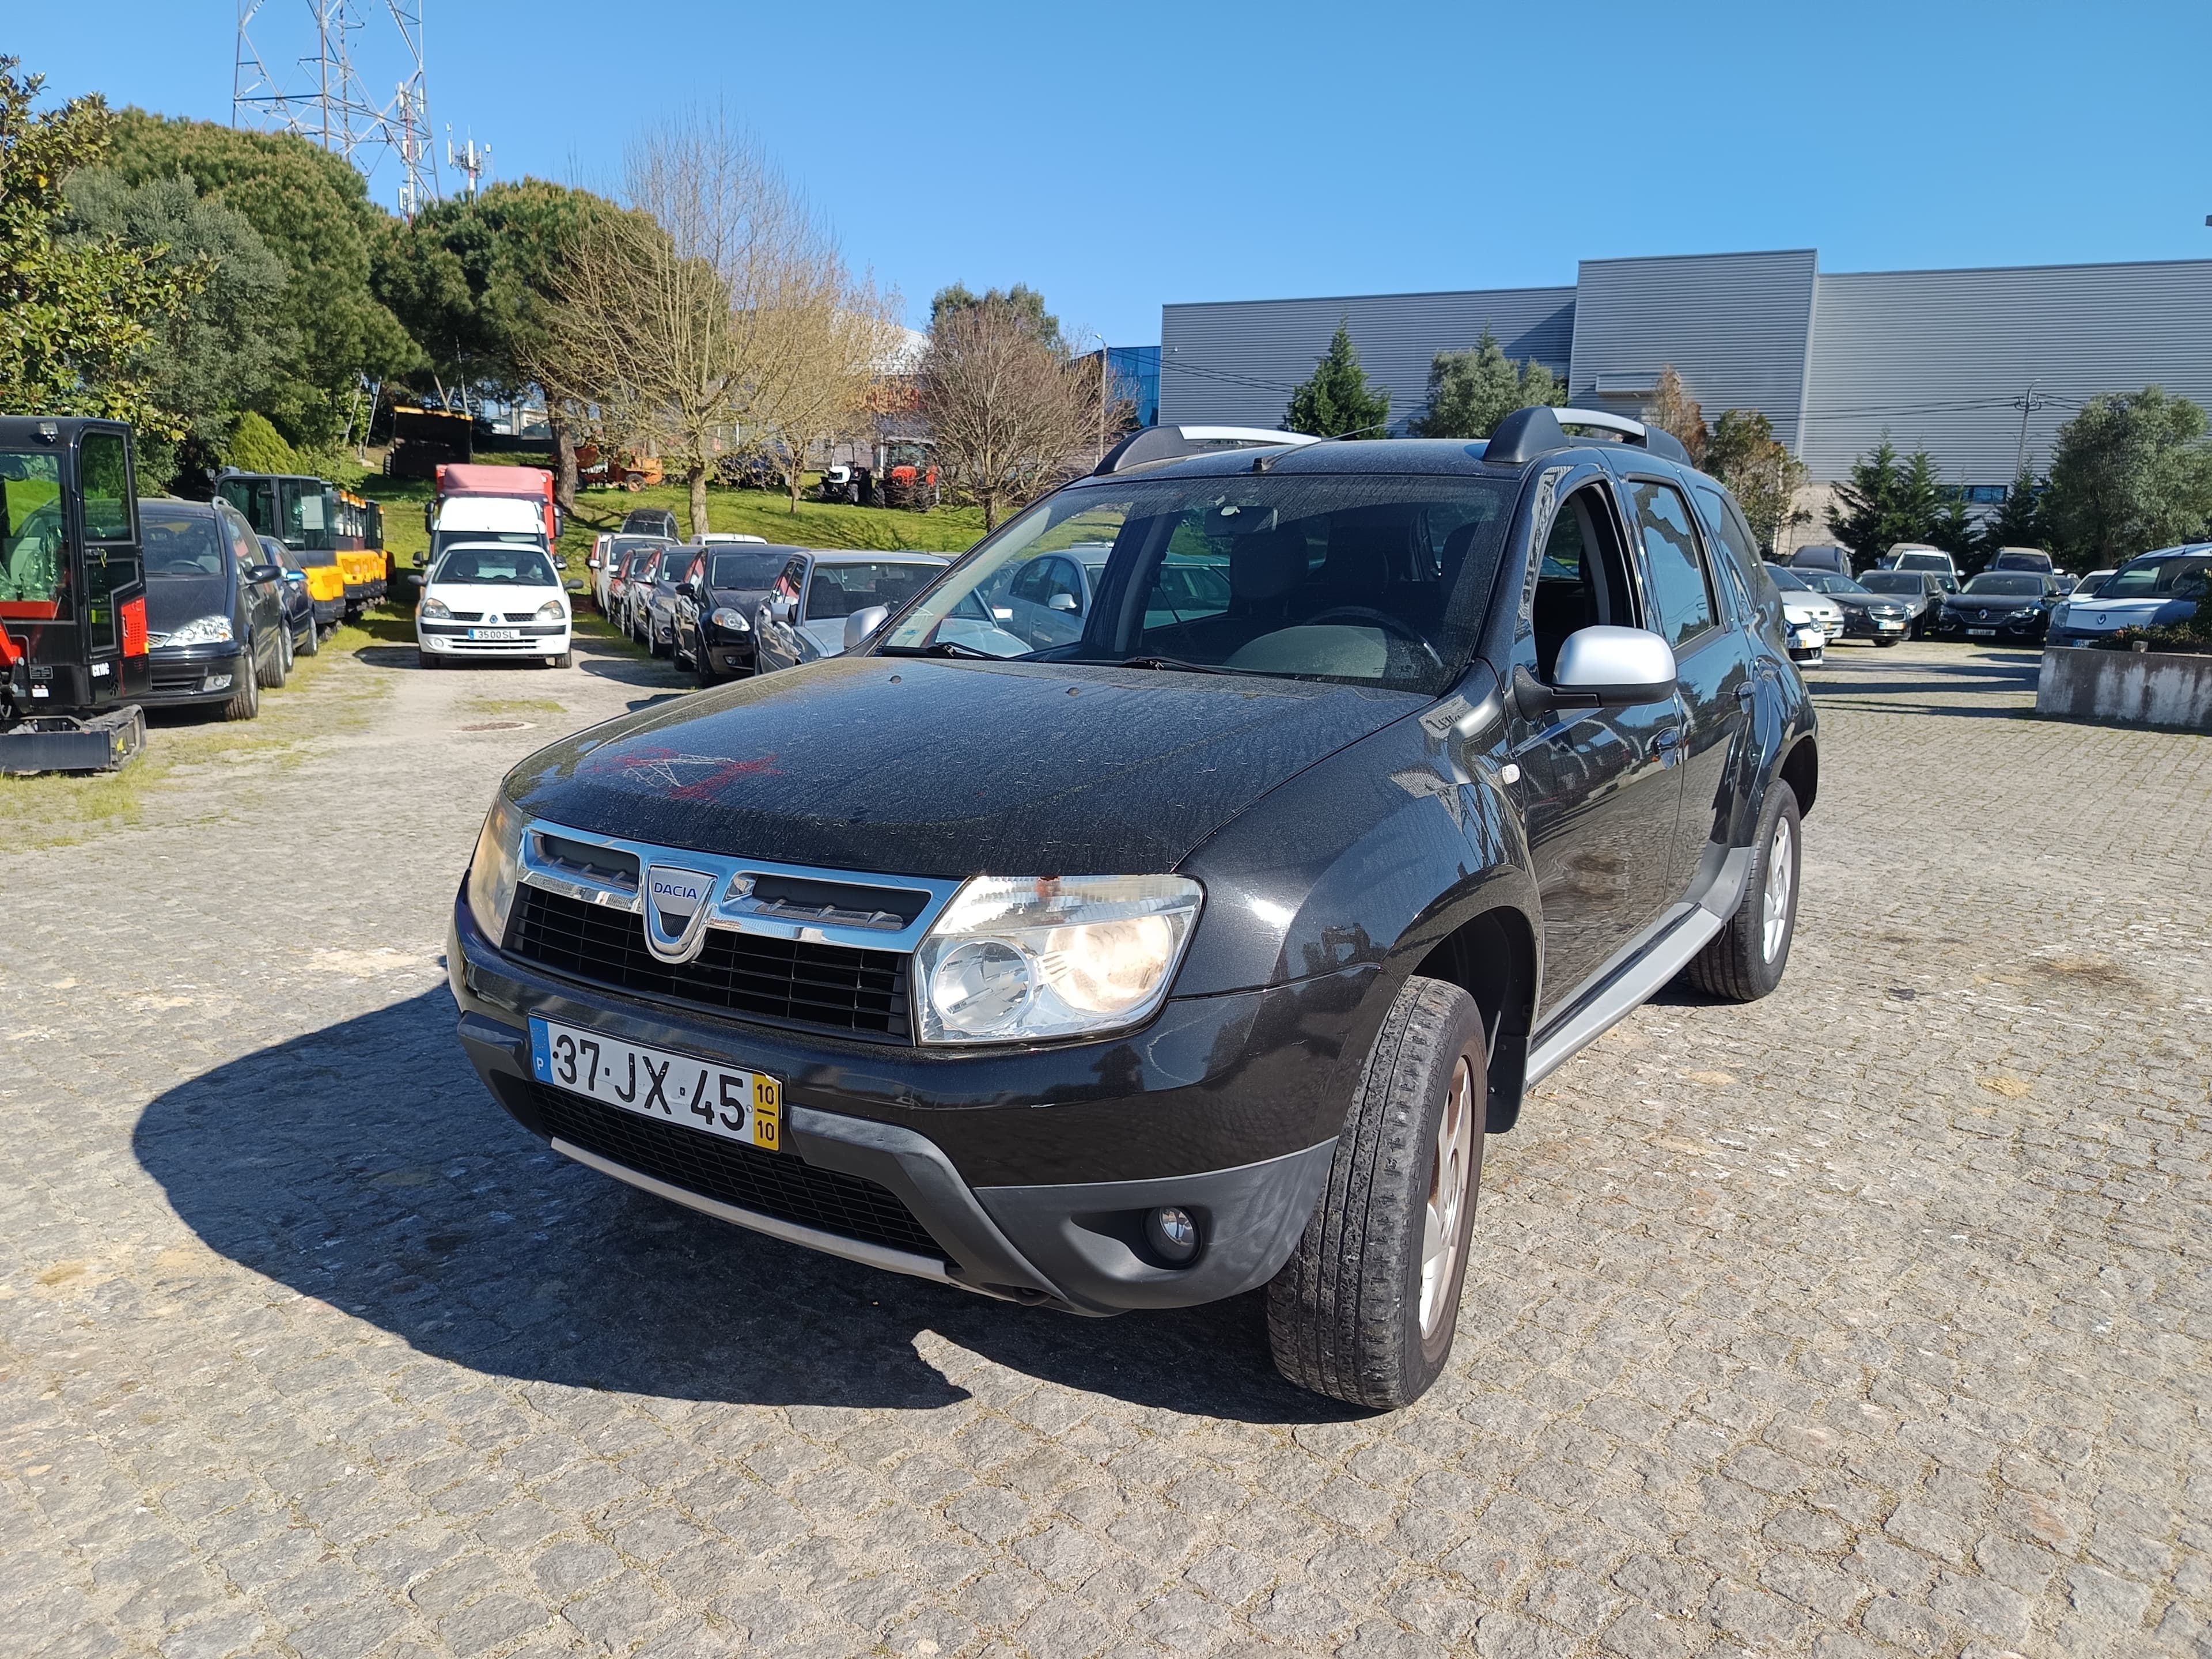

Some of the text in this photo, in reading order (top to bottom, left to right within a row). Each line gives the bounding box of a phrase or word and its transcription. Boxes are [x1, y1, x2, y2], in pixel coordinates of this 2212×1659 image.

[654, 882, 697, 900] DACIA
[537, 1056, 544, 1071] P
[756, 1083, 775, 1105] 10
[756, 1119, 775, 1142] 10
